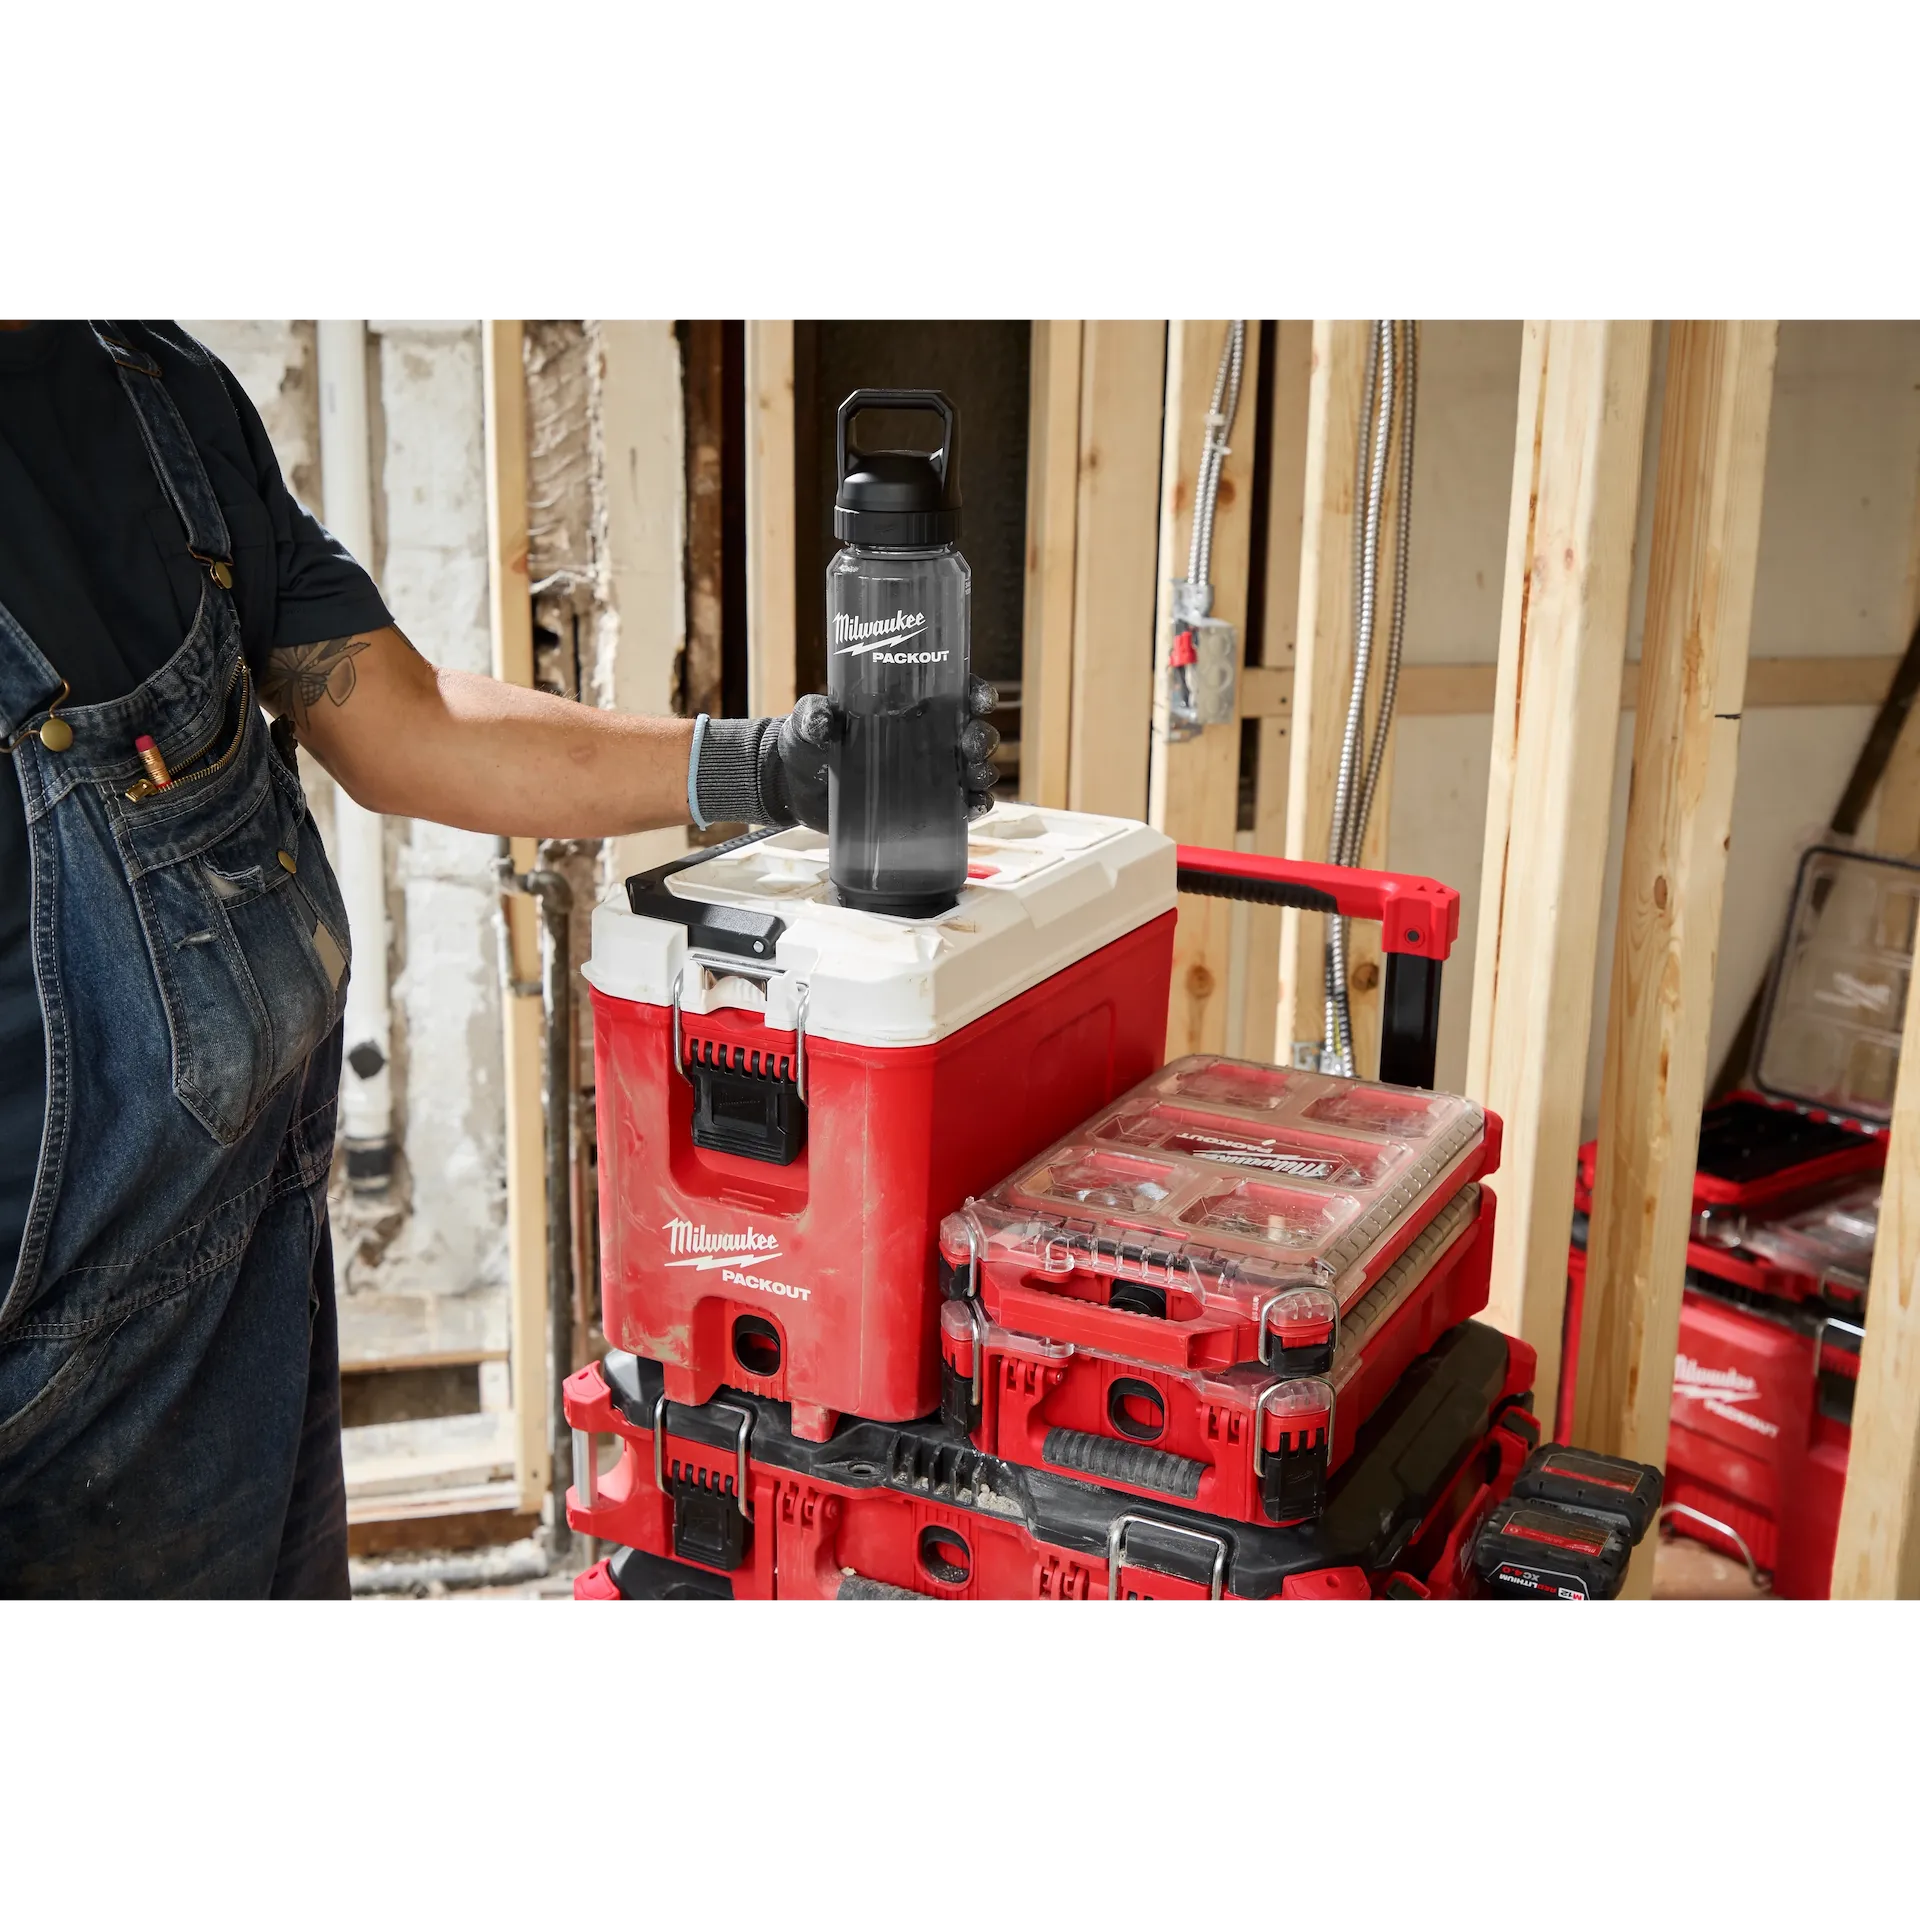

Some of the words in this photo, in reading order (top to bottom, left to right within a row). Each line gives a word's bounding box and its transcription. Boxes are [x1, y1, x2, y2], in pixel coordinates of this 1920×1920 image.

[832, 610, 926, 645] Milwaukee
[873, 650, 949, 664] PACKOUT
[1176, 1132, 1273, 1154] PACKOUT
[662, 1217, 779, 1255] Milwaukee
[722, 1269, 811, 1301] PACKOUT
[1499, 1573, 1557, 1594] REDLITHIUM
[1559, 1589, 1583, 1604] M12
